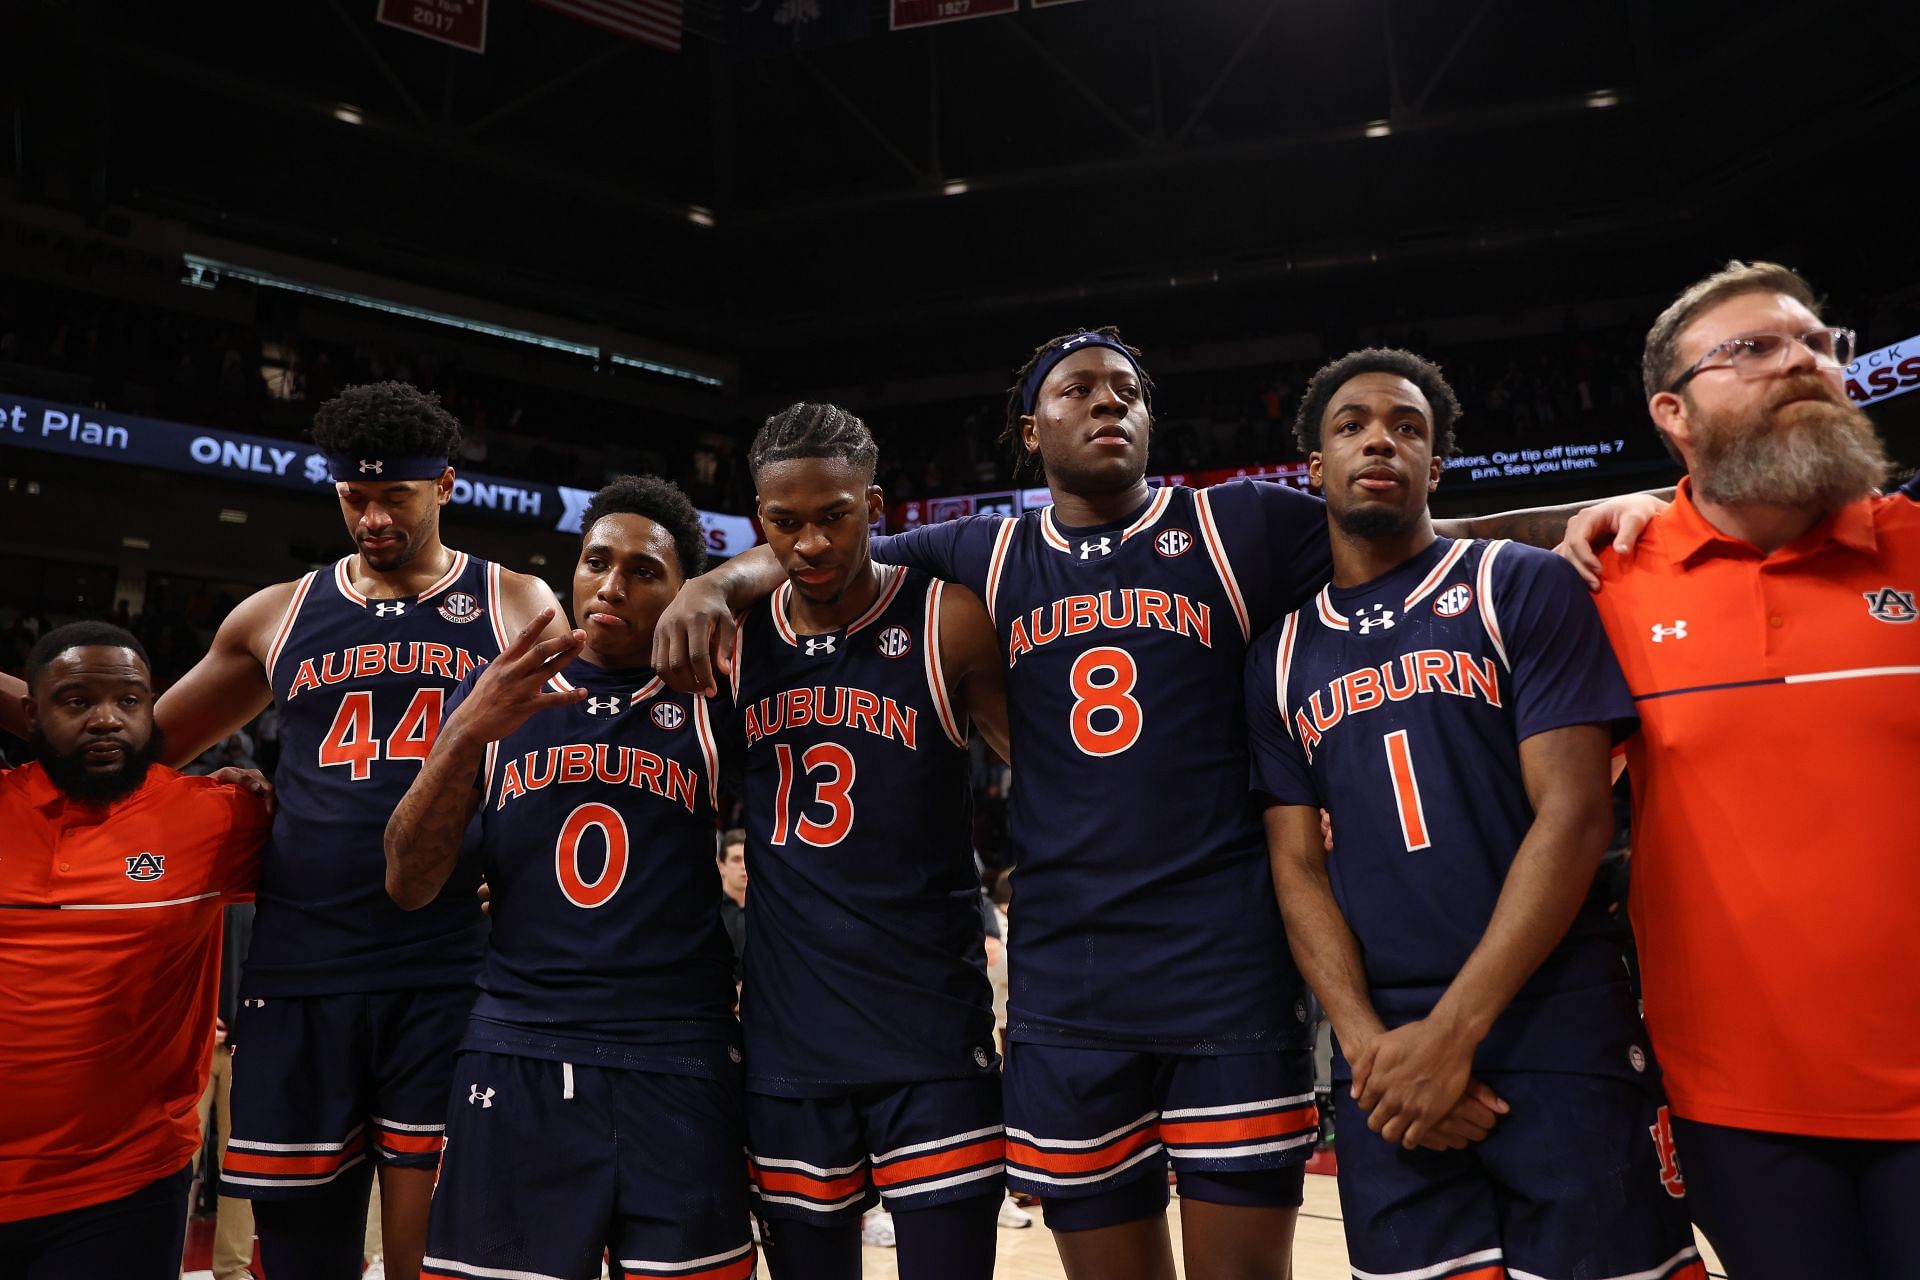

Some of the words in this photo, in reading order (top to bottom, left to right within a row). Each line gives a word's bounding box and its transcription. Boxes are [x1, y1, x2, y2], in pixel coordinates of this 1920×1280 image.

[413, 6, 455, 32] 2017
[41, 409, 129, 449] Plan
[190, 436, 296, 476] ONLY
[451, 478, 542, 516] ONTH
[1492, 451, 1519, 464] Our
[1521, 448, 1541, 462] tip
[1543, 445, 1562, 459] off
[1565, 443, 1598, 457] time
[1600, 441, 1612, 454] is
[1614, 439, 1624, 452] 7
[1504, 463, 1531, 476] See
[1533, 461, 1560, 475] you
[1561, 457, 1598, 471] then.
[1159, 531, 1191, 555] SEC
[447, 593, 474, 615] SEC
[1009, 588, 1212, 669] AUBURN
[1437, 585, 1470, 615] SEC
[287, 641, 489, 701] AUBURN
[878, 626, 908, 656] SEC
[318, 687, 445, 781] 44
[654, 704, 683, 728] SEC
[745, 686, 918, 751] AUBURN
[1069, 646, 1143, 757] 8
[1295, 649, 1503, 766] AUBURN
[497, 743, 698, 814] AUBURN
[770, 742, 857, 848] 13
[1383, 729, 1432, 853] 1
[555, 802, 629, 909] 0
